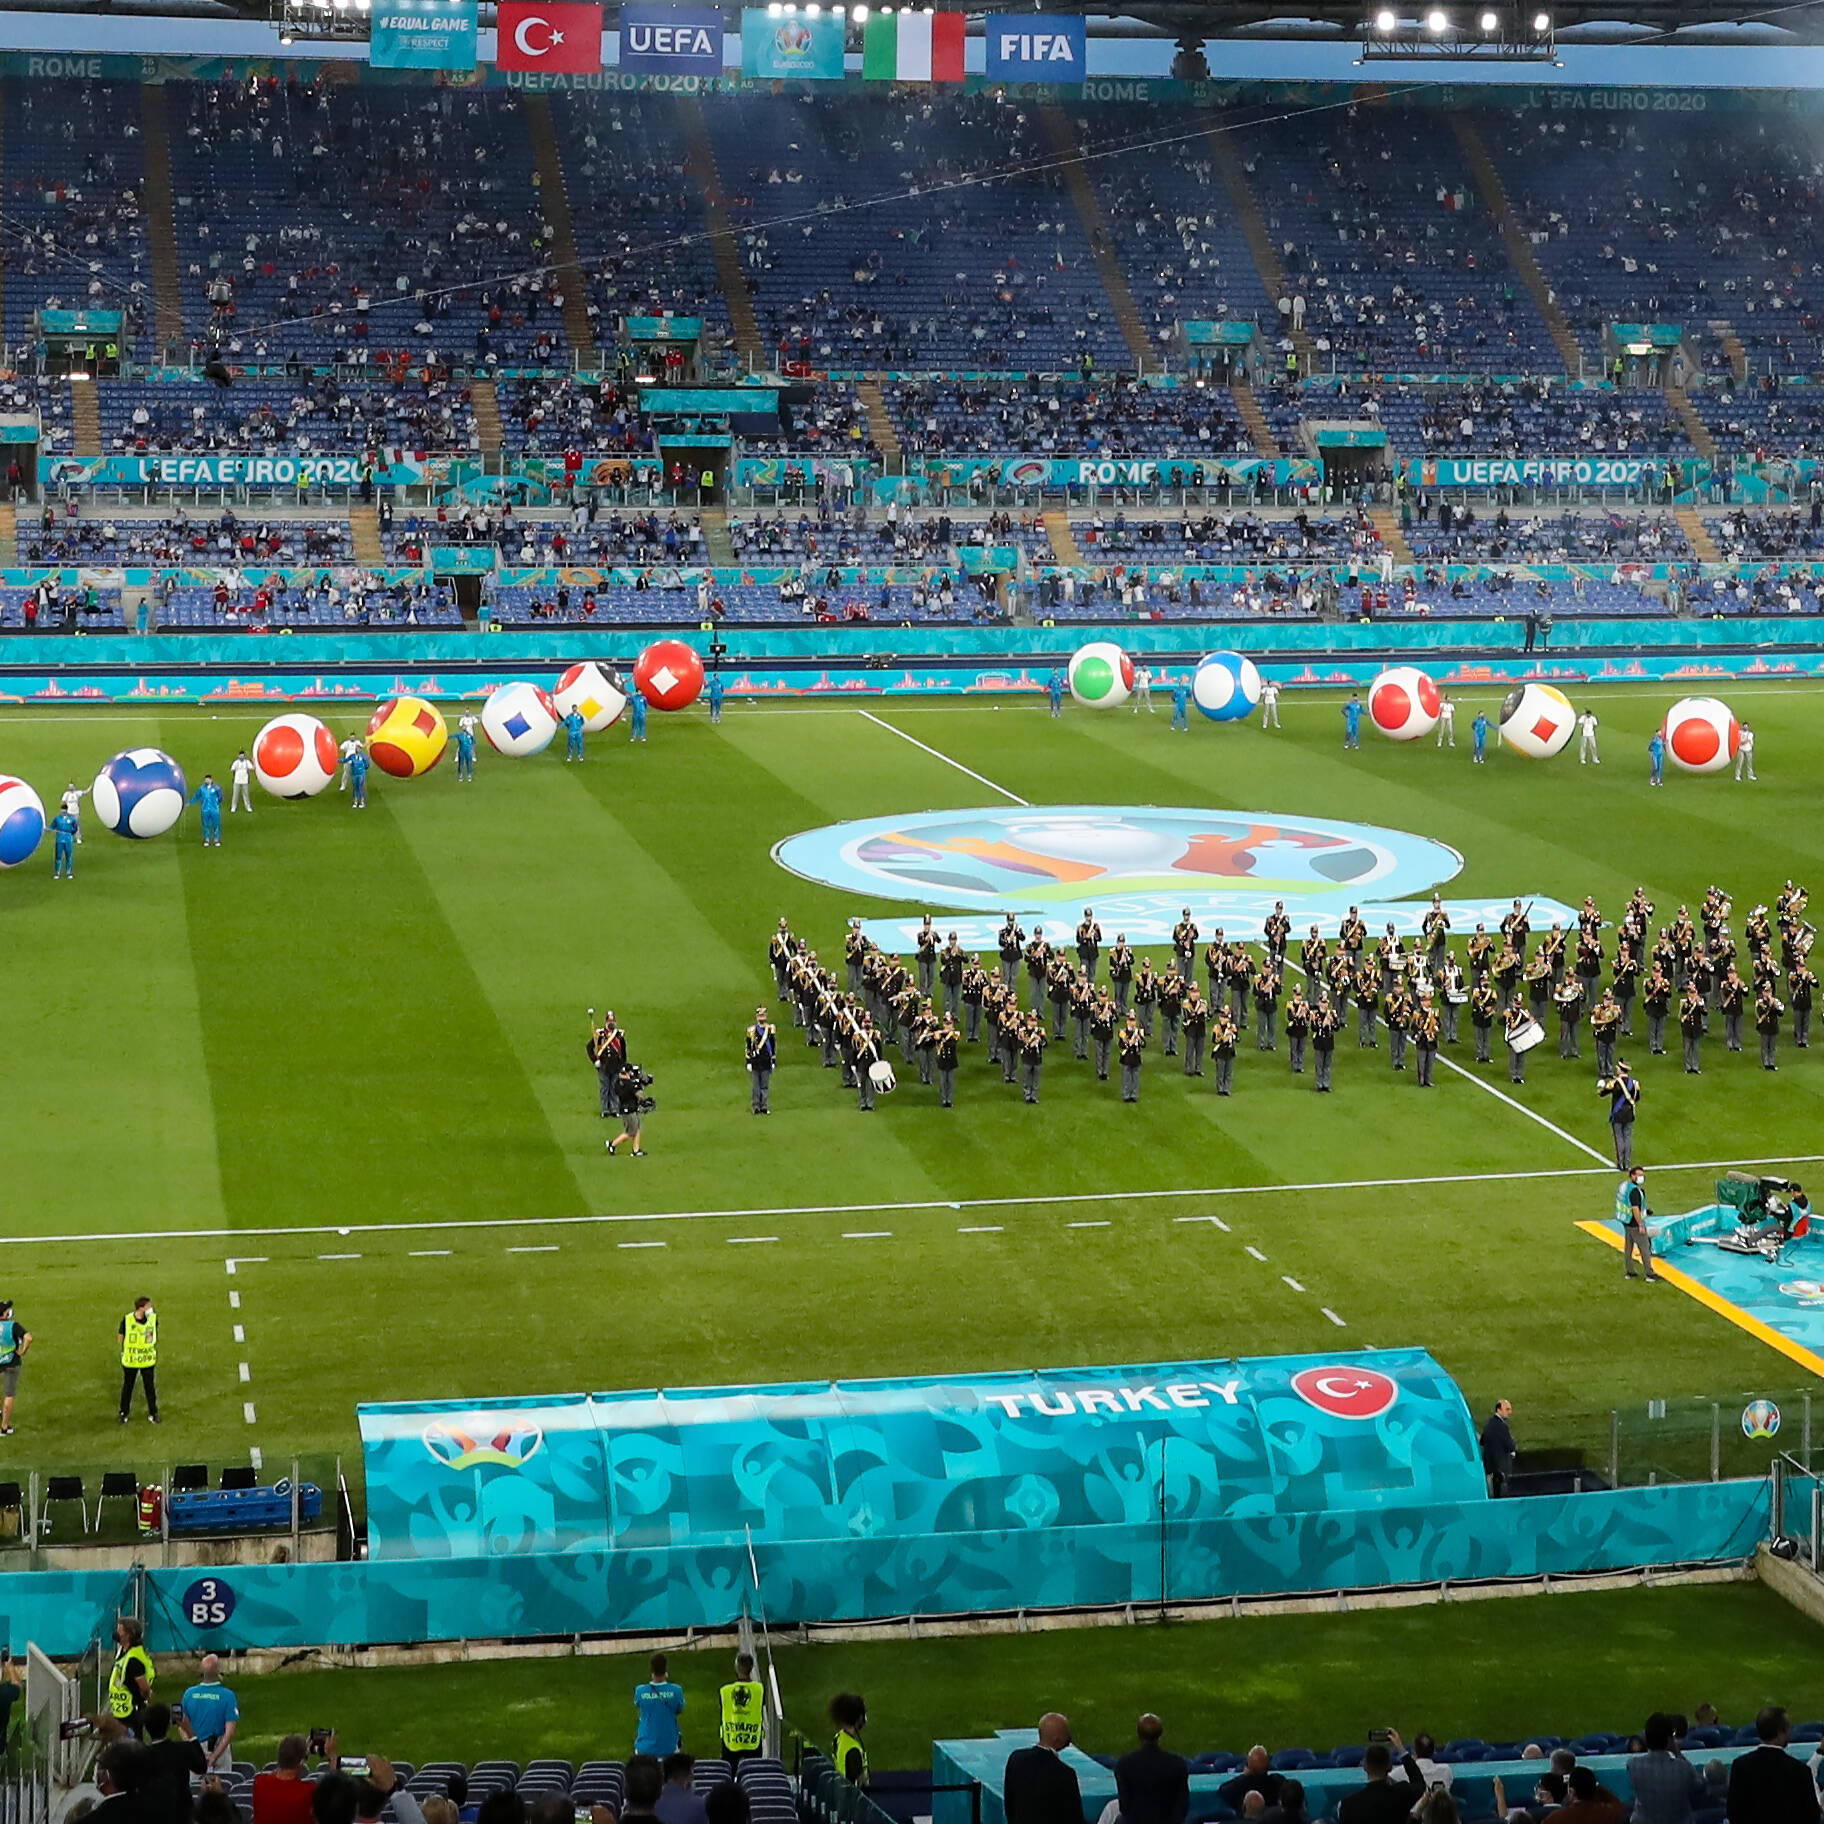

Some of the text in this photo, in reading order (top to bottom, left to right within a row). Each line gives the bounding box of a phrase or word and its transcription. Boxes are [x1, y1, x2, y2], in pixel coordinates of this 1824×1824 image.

[379, 17, 469, 33] #EQUAL GAME
[629, 27, 713, 54] UEFA
[999, 34, 1074, 61] FIFA
[28, 57, 102, 77] ROME
[506, 70, 567, 88] UEFA
[573, 72, 636, 90] EURO
[1081, 82, 1149, 101] ROME
[1590, 92, 1649, 110] EURO
[1654, 93, 1706, 111] 2020
[1079, 462, 1157, 484] ROME
[1453, 462, 1520, 483] UEFA
[984, 1380, 1240, 1418] TURKEY
[201, 1581, 217, 1601] 3
[192, 1602, 226, 1624] BS
